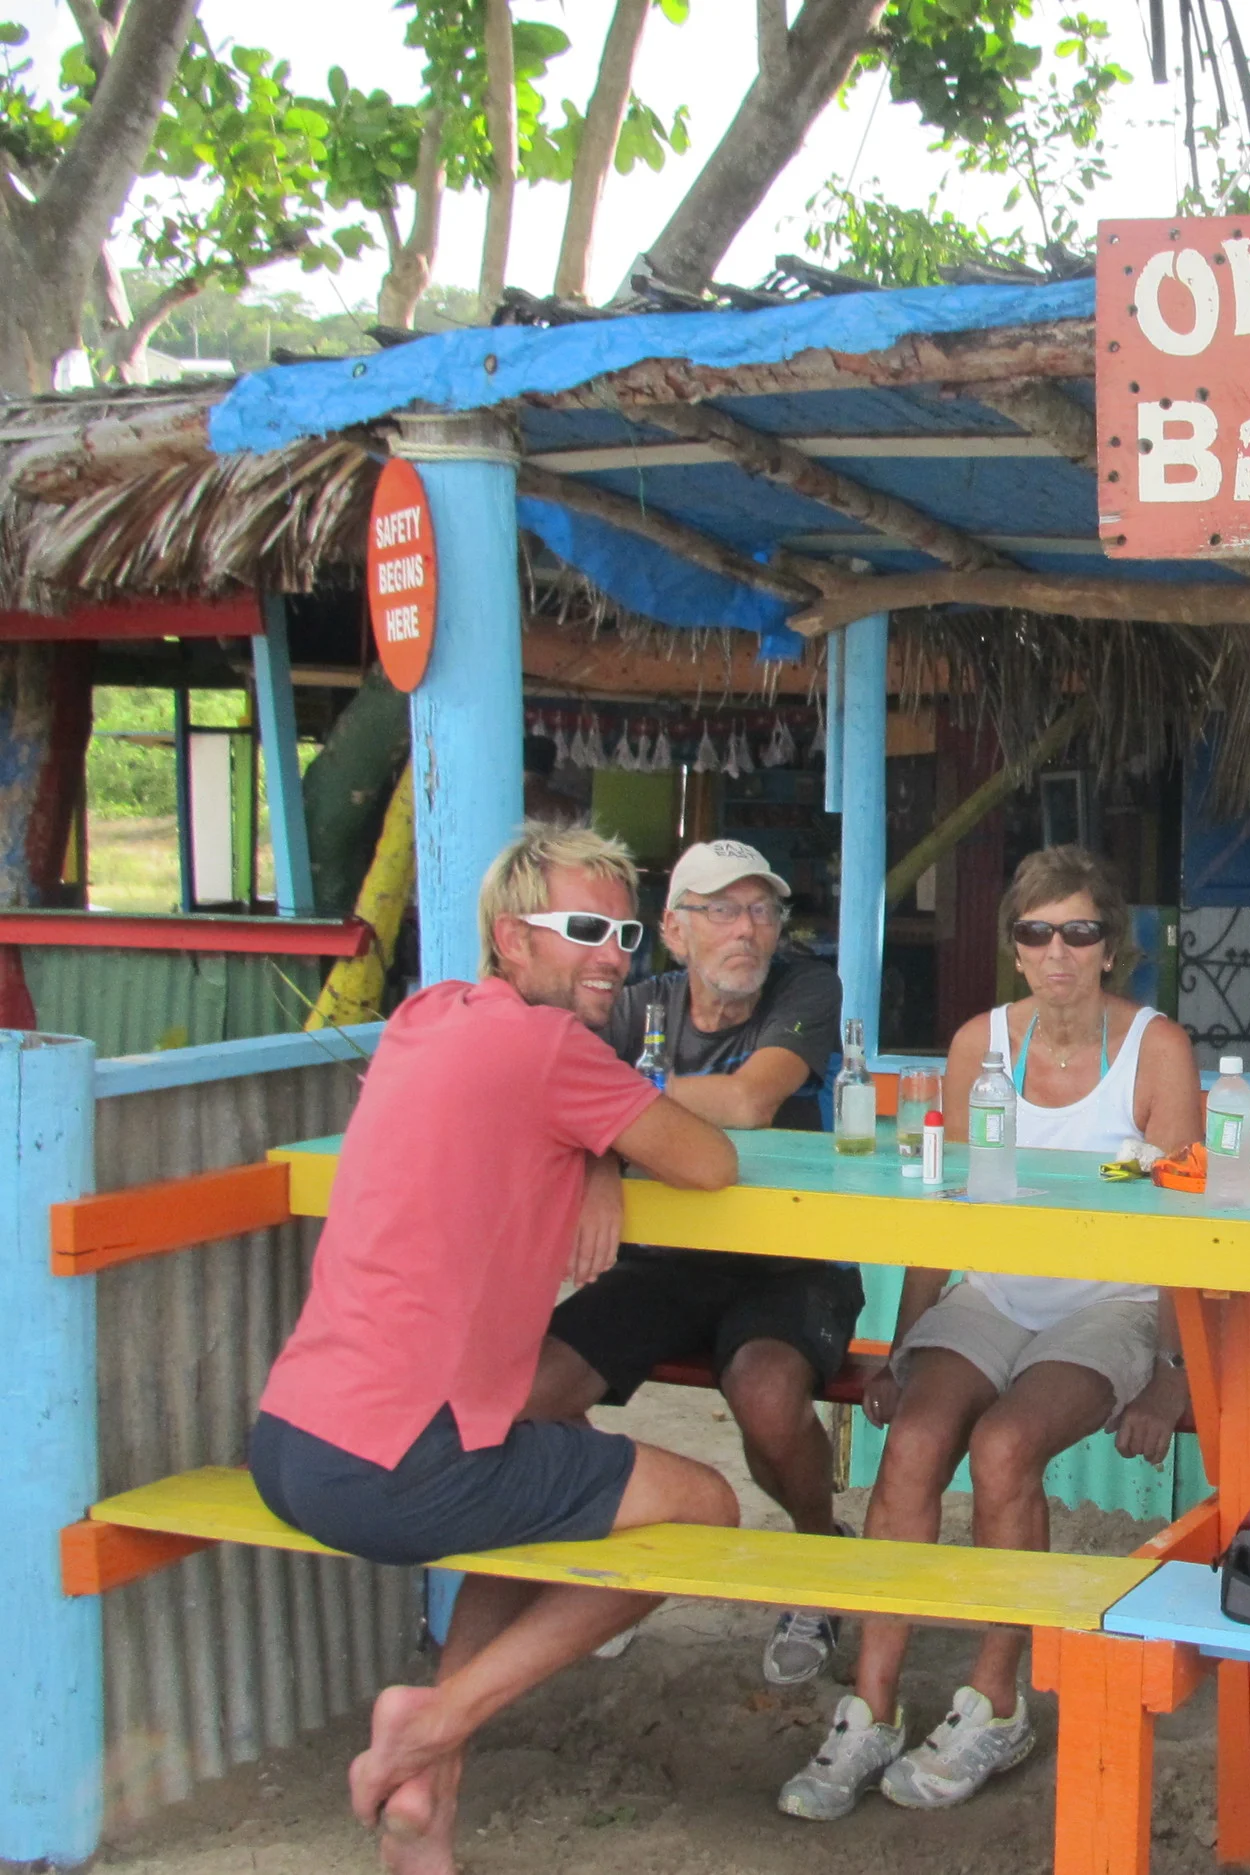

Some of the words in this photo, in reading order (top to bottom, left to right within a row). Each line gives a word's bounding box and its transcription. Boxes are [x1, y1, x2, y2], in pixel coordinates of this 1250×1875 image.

[375, 505, 421, 549] SAFETY
[377, 553, 424, 595] BEGINS
[385, 603, 420, 643] HERE
